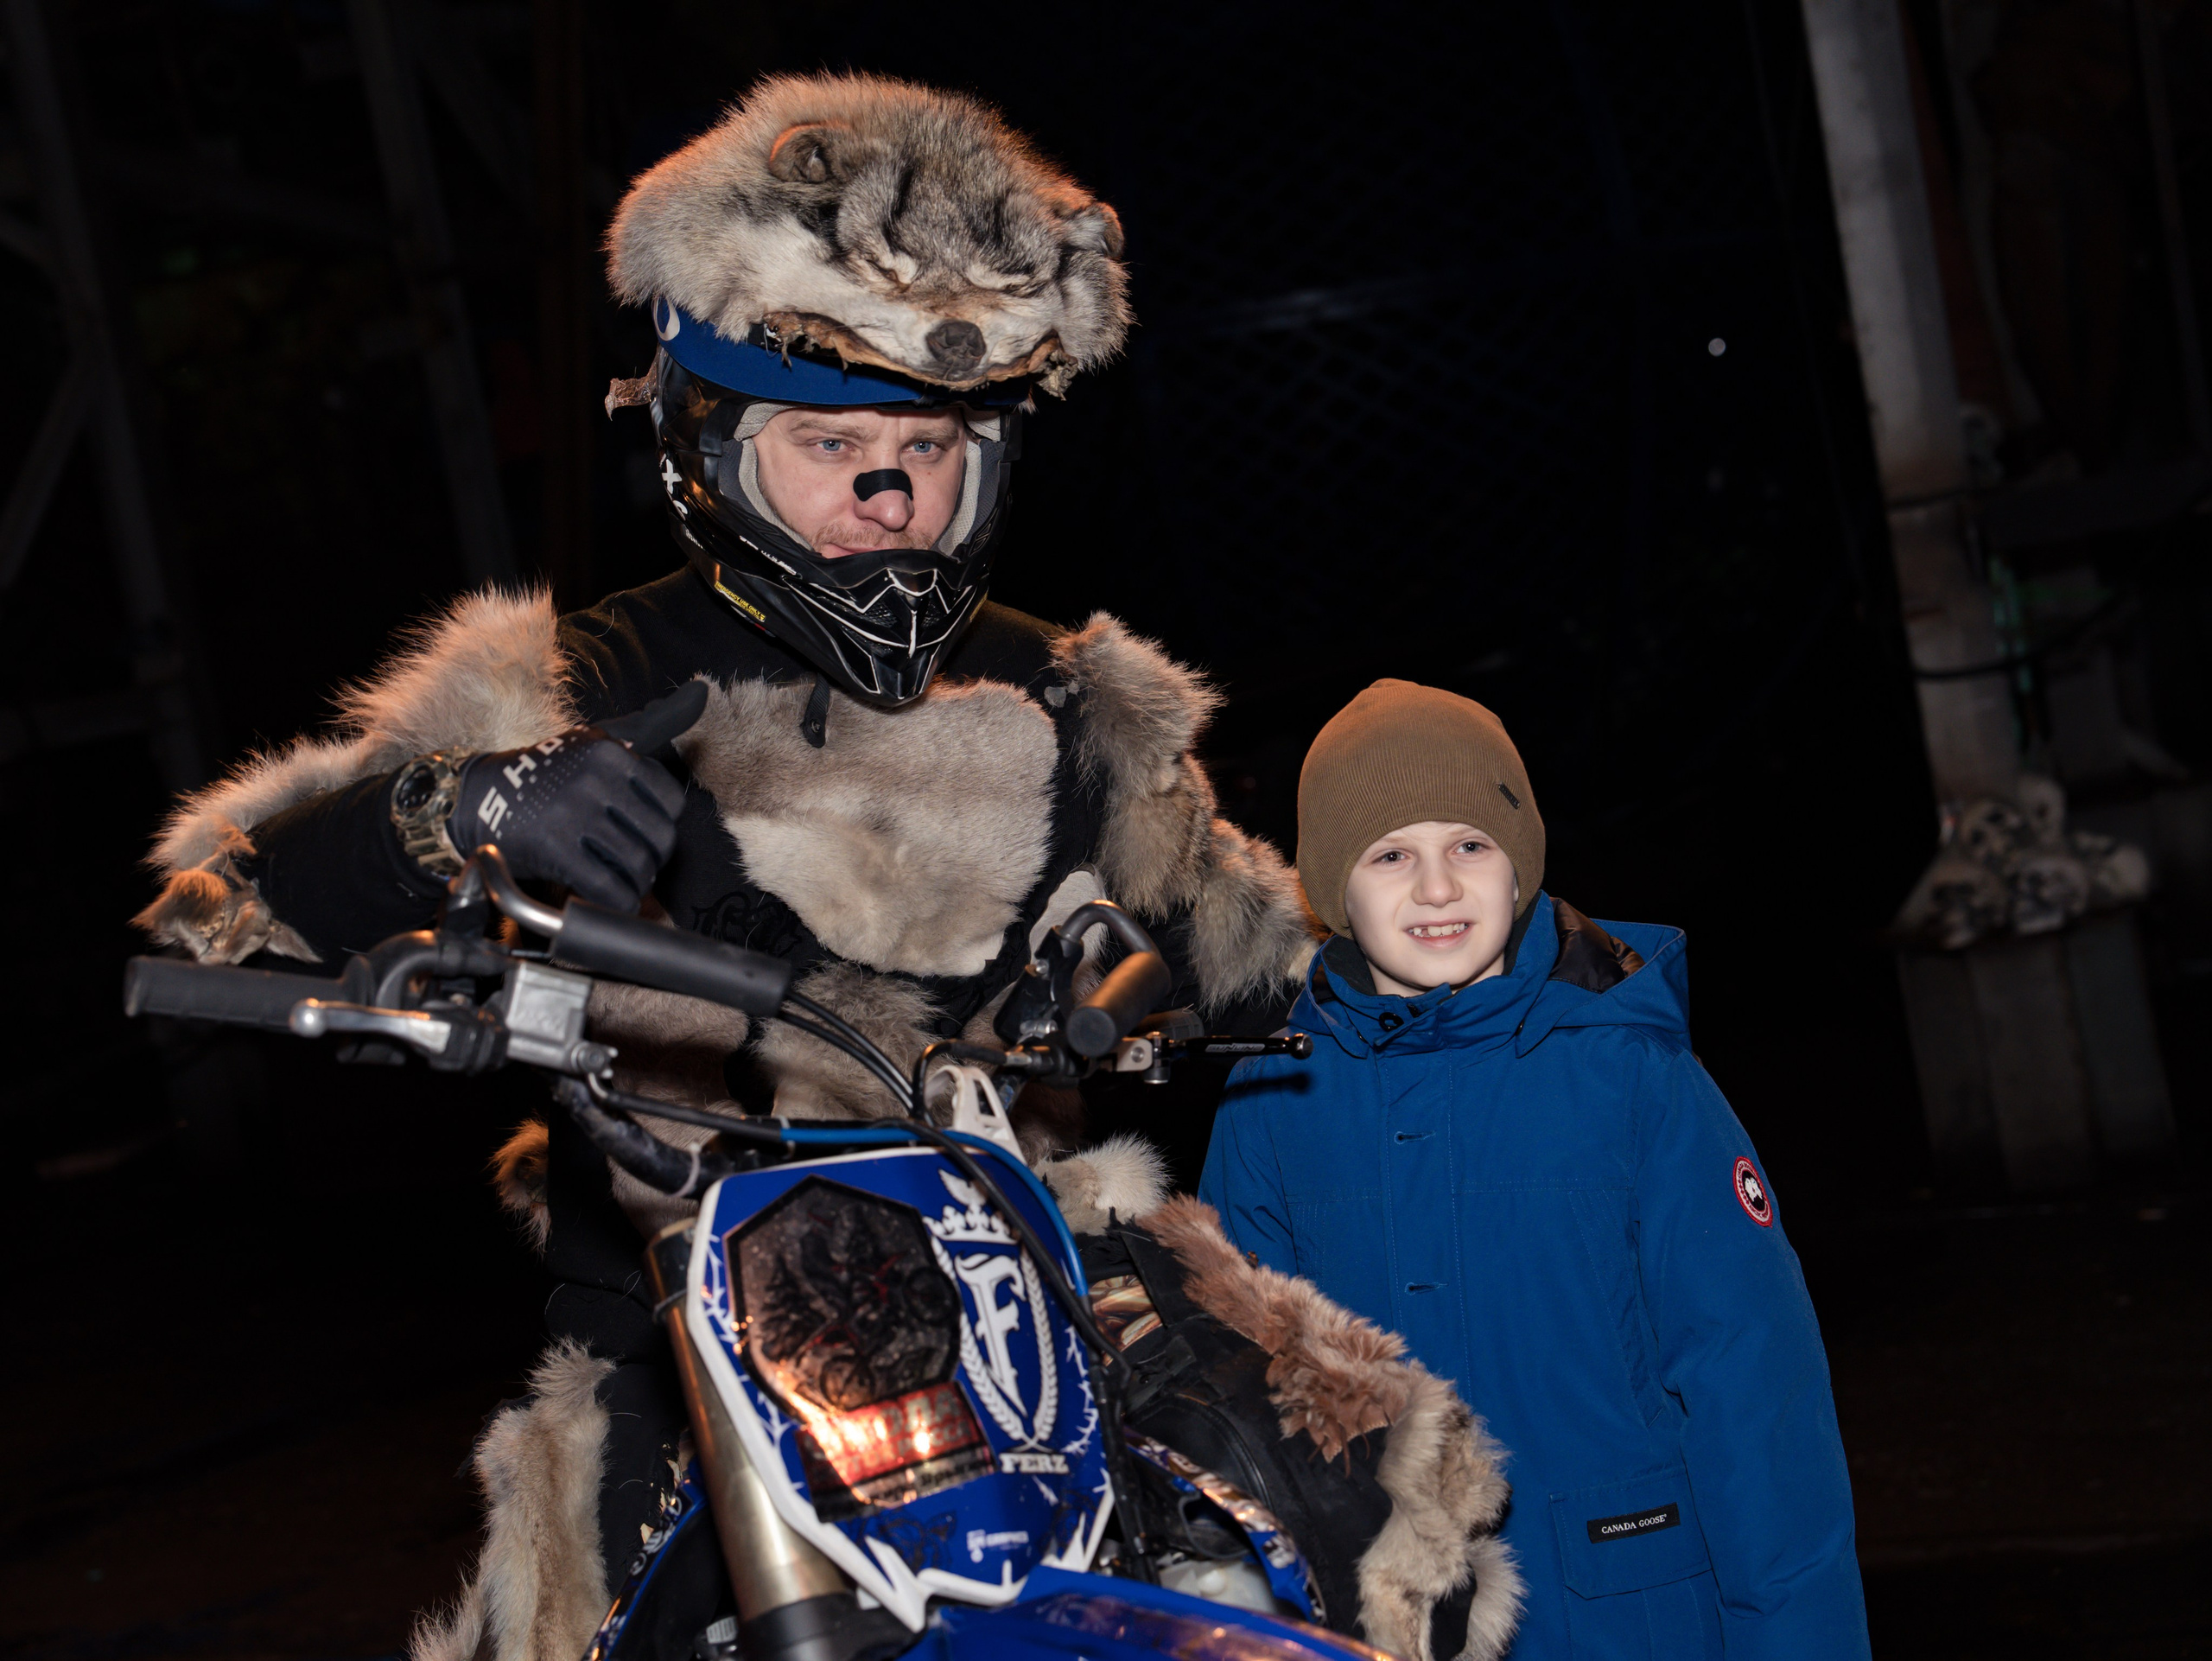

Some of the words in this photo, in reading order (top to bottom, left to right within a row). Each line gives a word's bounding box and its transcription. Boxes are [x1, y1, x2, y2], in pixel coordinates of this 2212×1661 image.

[478, 735, 565, 832] SHO
[999, 1453, 1070, 1473] FERZ
[1601, 1521, 1637, 1534] CANADA
